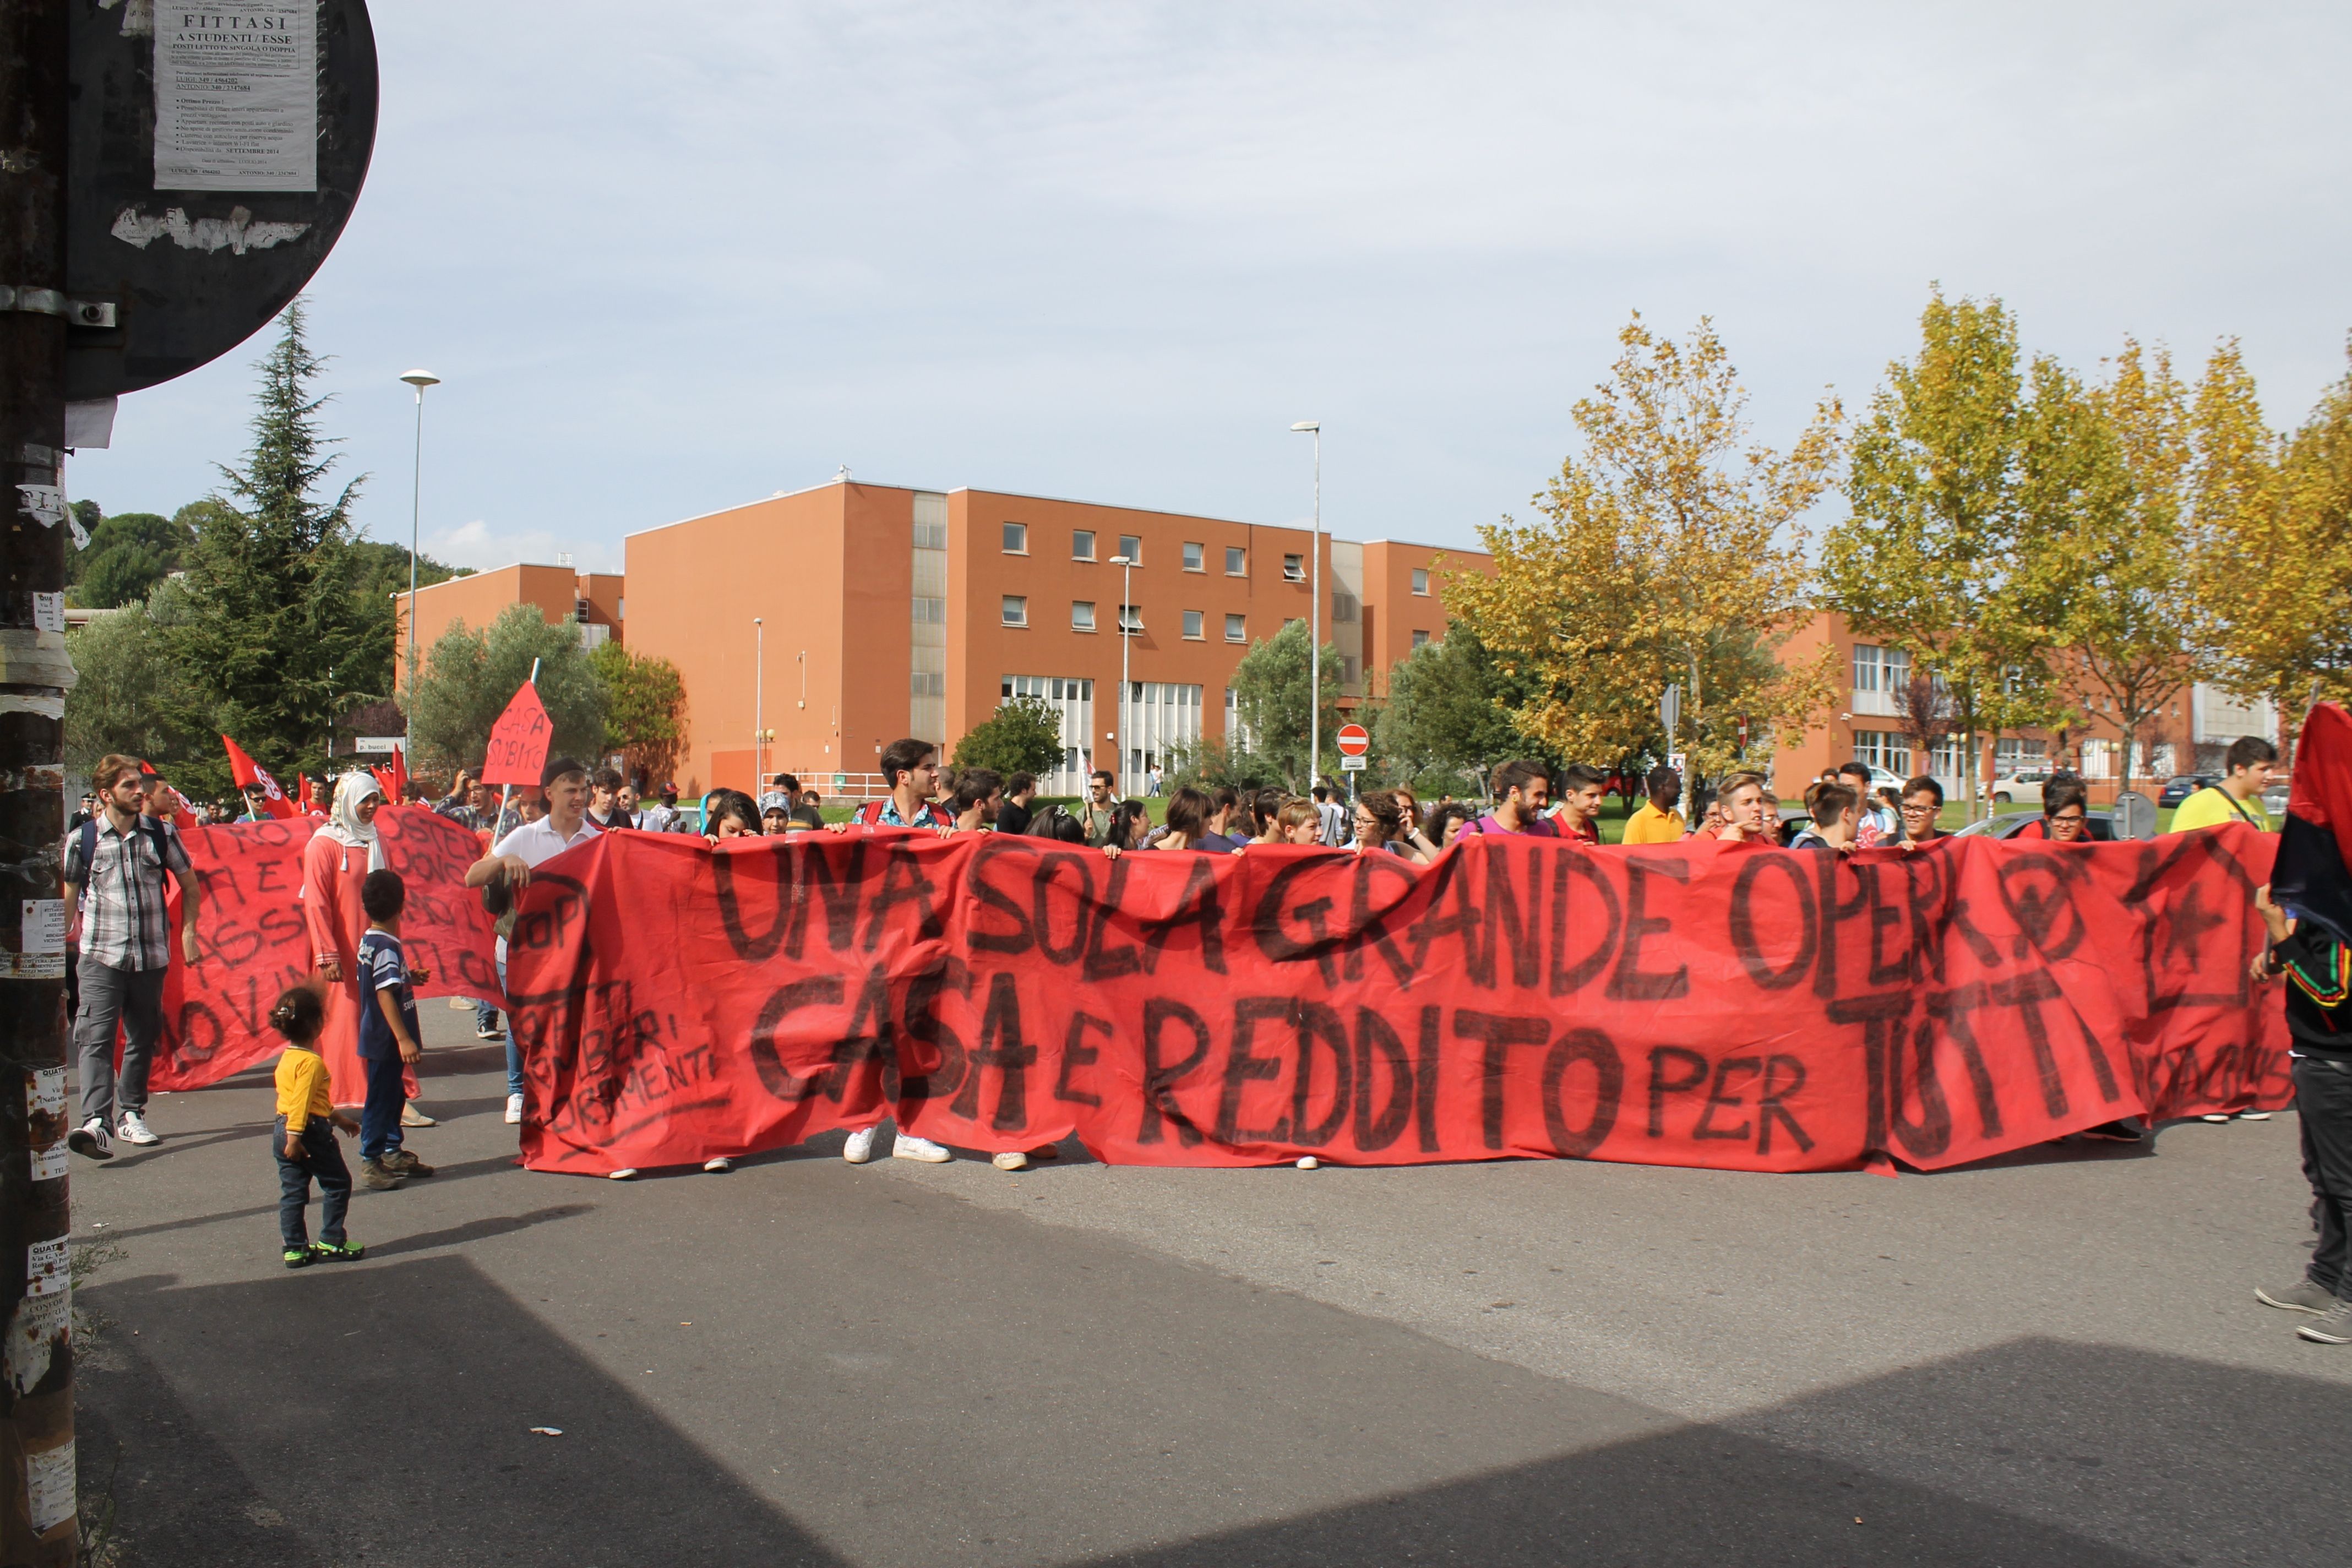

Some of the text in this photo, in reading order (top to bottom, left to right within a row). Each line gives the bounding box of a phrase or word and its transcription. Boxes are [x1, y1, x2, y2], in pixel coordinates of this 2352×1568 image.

[184, 14, 286, 30] FITTASI
[176, 33, 292, 45] A STUDENTI / ESSE
[500, 706, 545, 736] CASA
[487, 738, 544, 770] SUBITO
[511, 894, 580, 953] TOP
[712, 834, 949, 962] UNA
[966, 840, 1228, 982] SOLA
[1253, 840, 1690, 1000] GRANDE
[751, 955, 1037, 1131] CASA
[1053, 1011, 1113, 1108] E
[1136, 995, 1625, 1158] REDDITO
[1646, 1044, 1817, 1156] PER
[1825, 966, 2121, 1163] TUTTI
[40, 1095, 57, 1104] (Nelle
